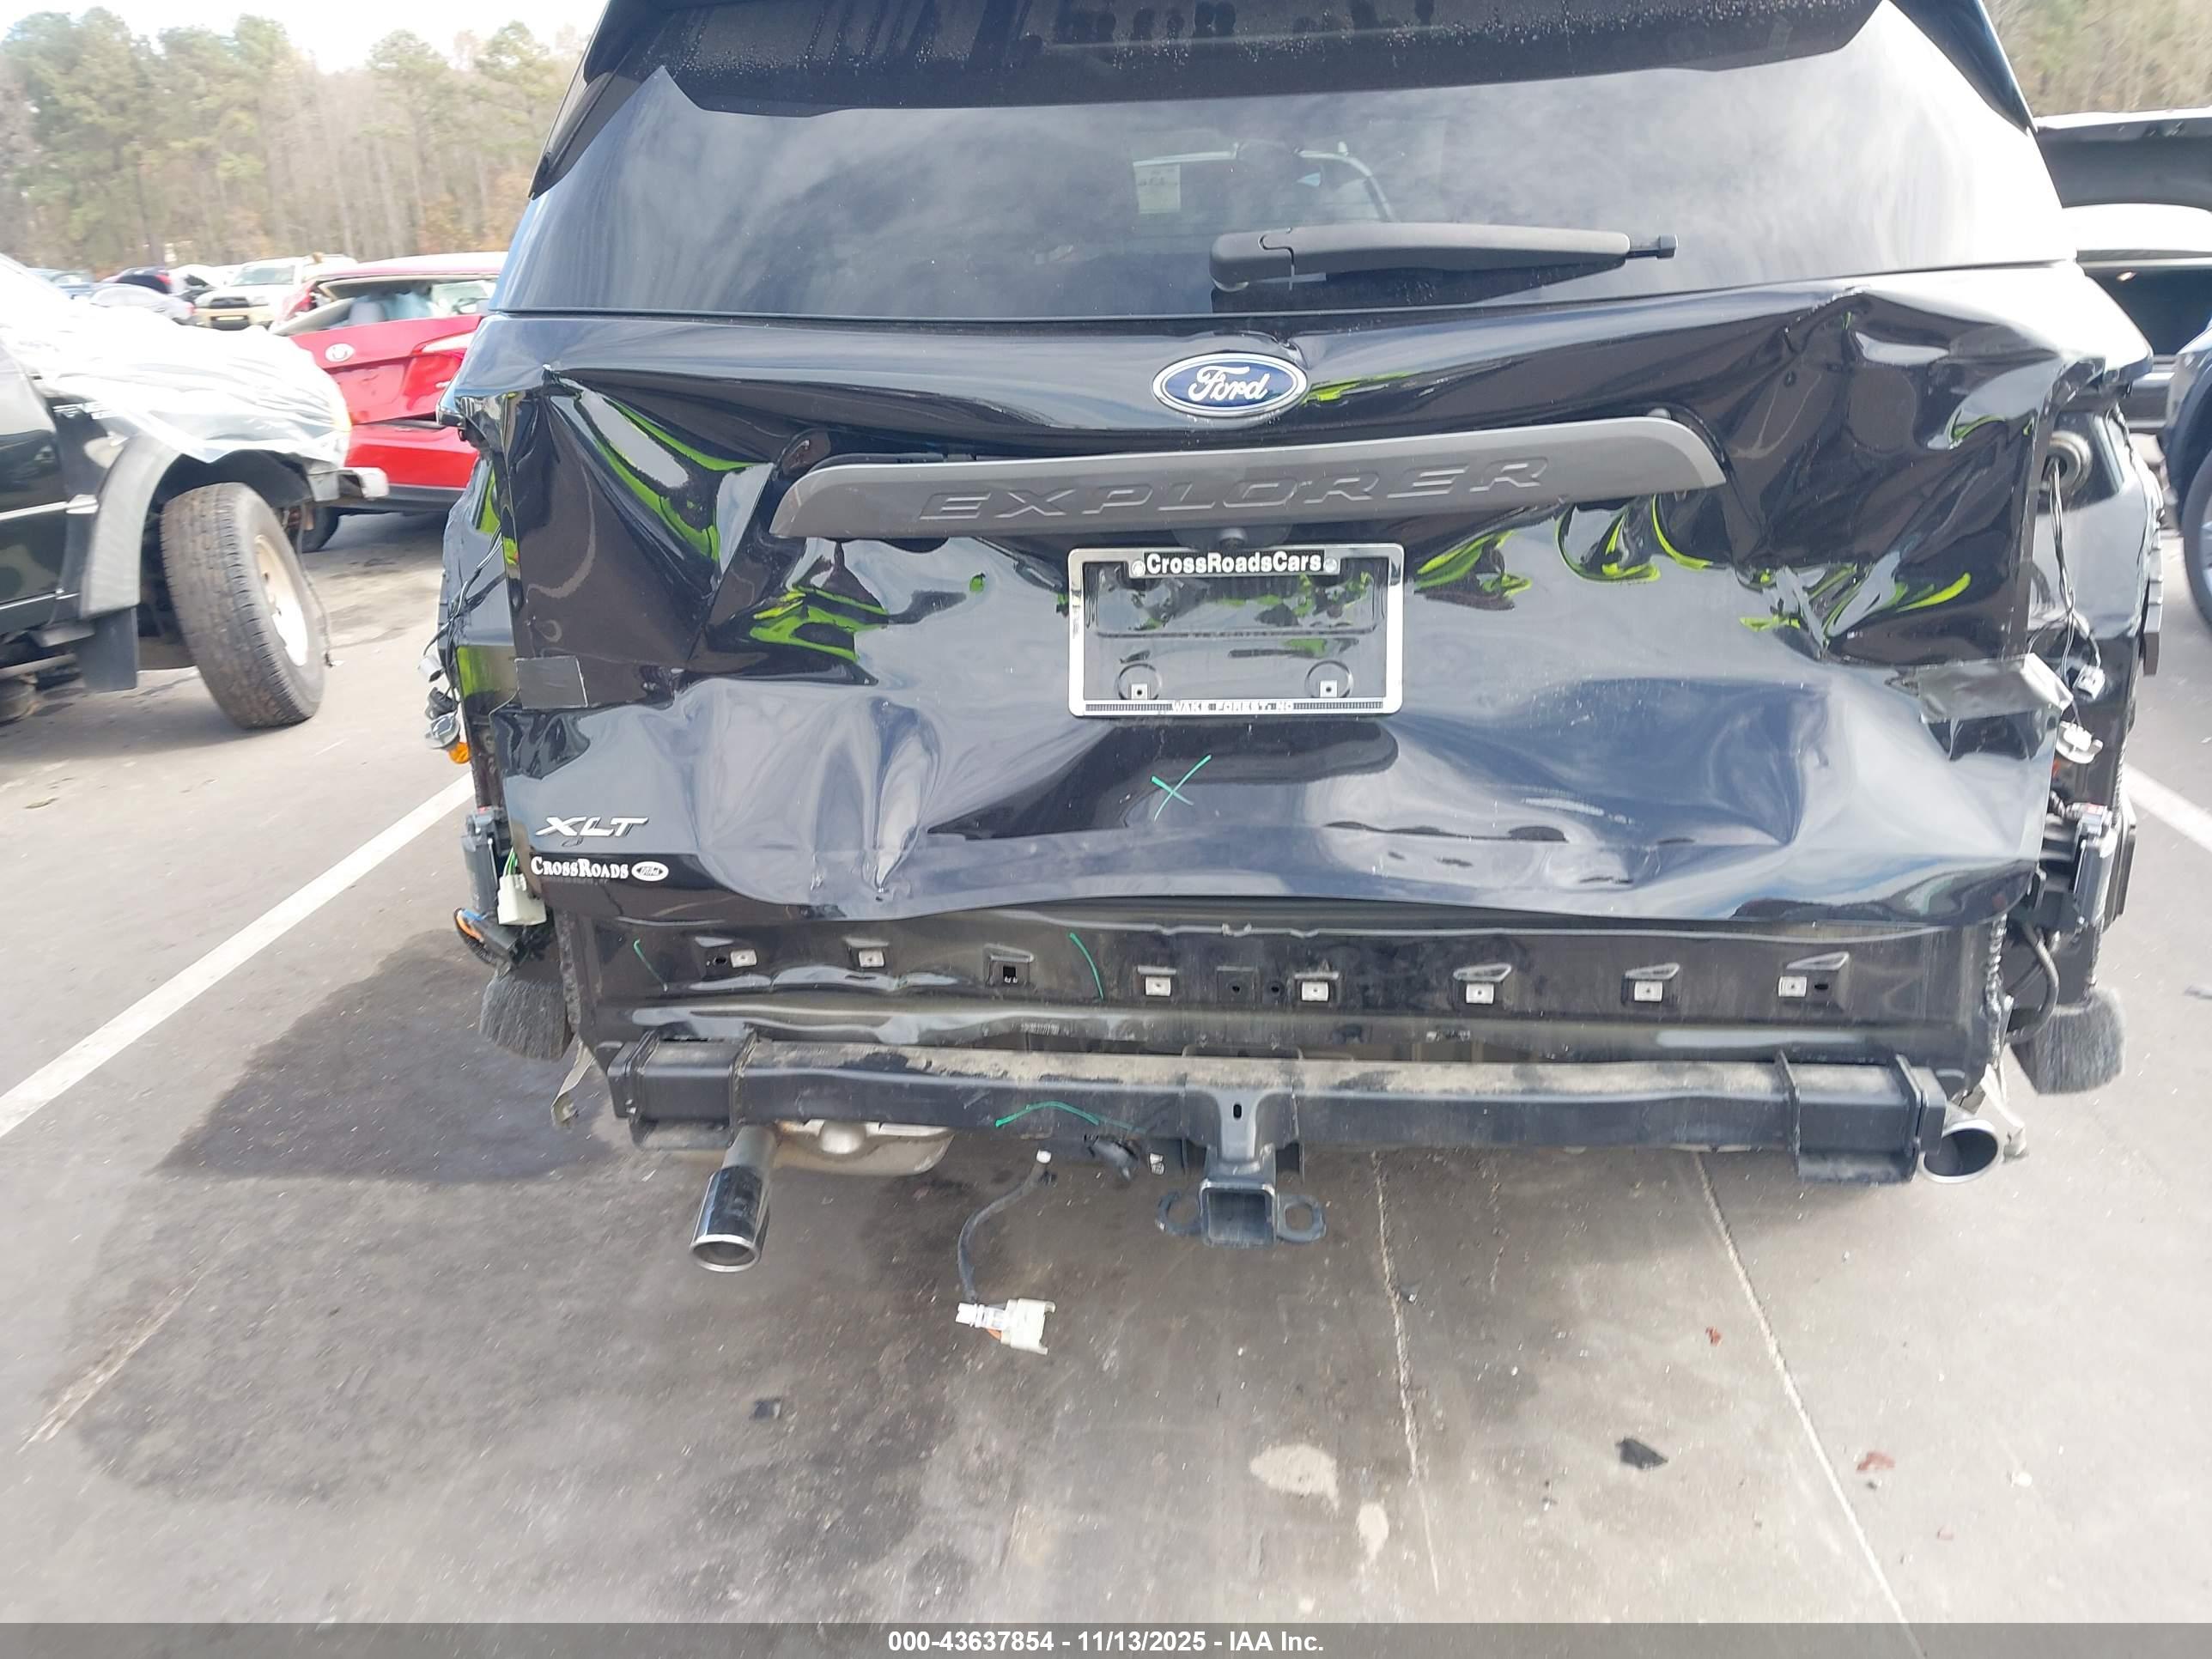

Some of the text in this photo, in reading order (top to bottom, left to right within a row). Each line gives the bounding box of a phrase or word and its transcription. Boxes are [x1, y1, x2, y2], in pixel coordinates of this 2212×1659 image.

[1188, 365, 1271, 401] Ford
[920, 456, 1547, 520] EXPLORER
[1146, 550, 1322, 574] CrossRoadsCars
[535, 816, 649, 837] XLT
